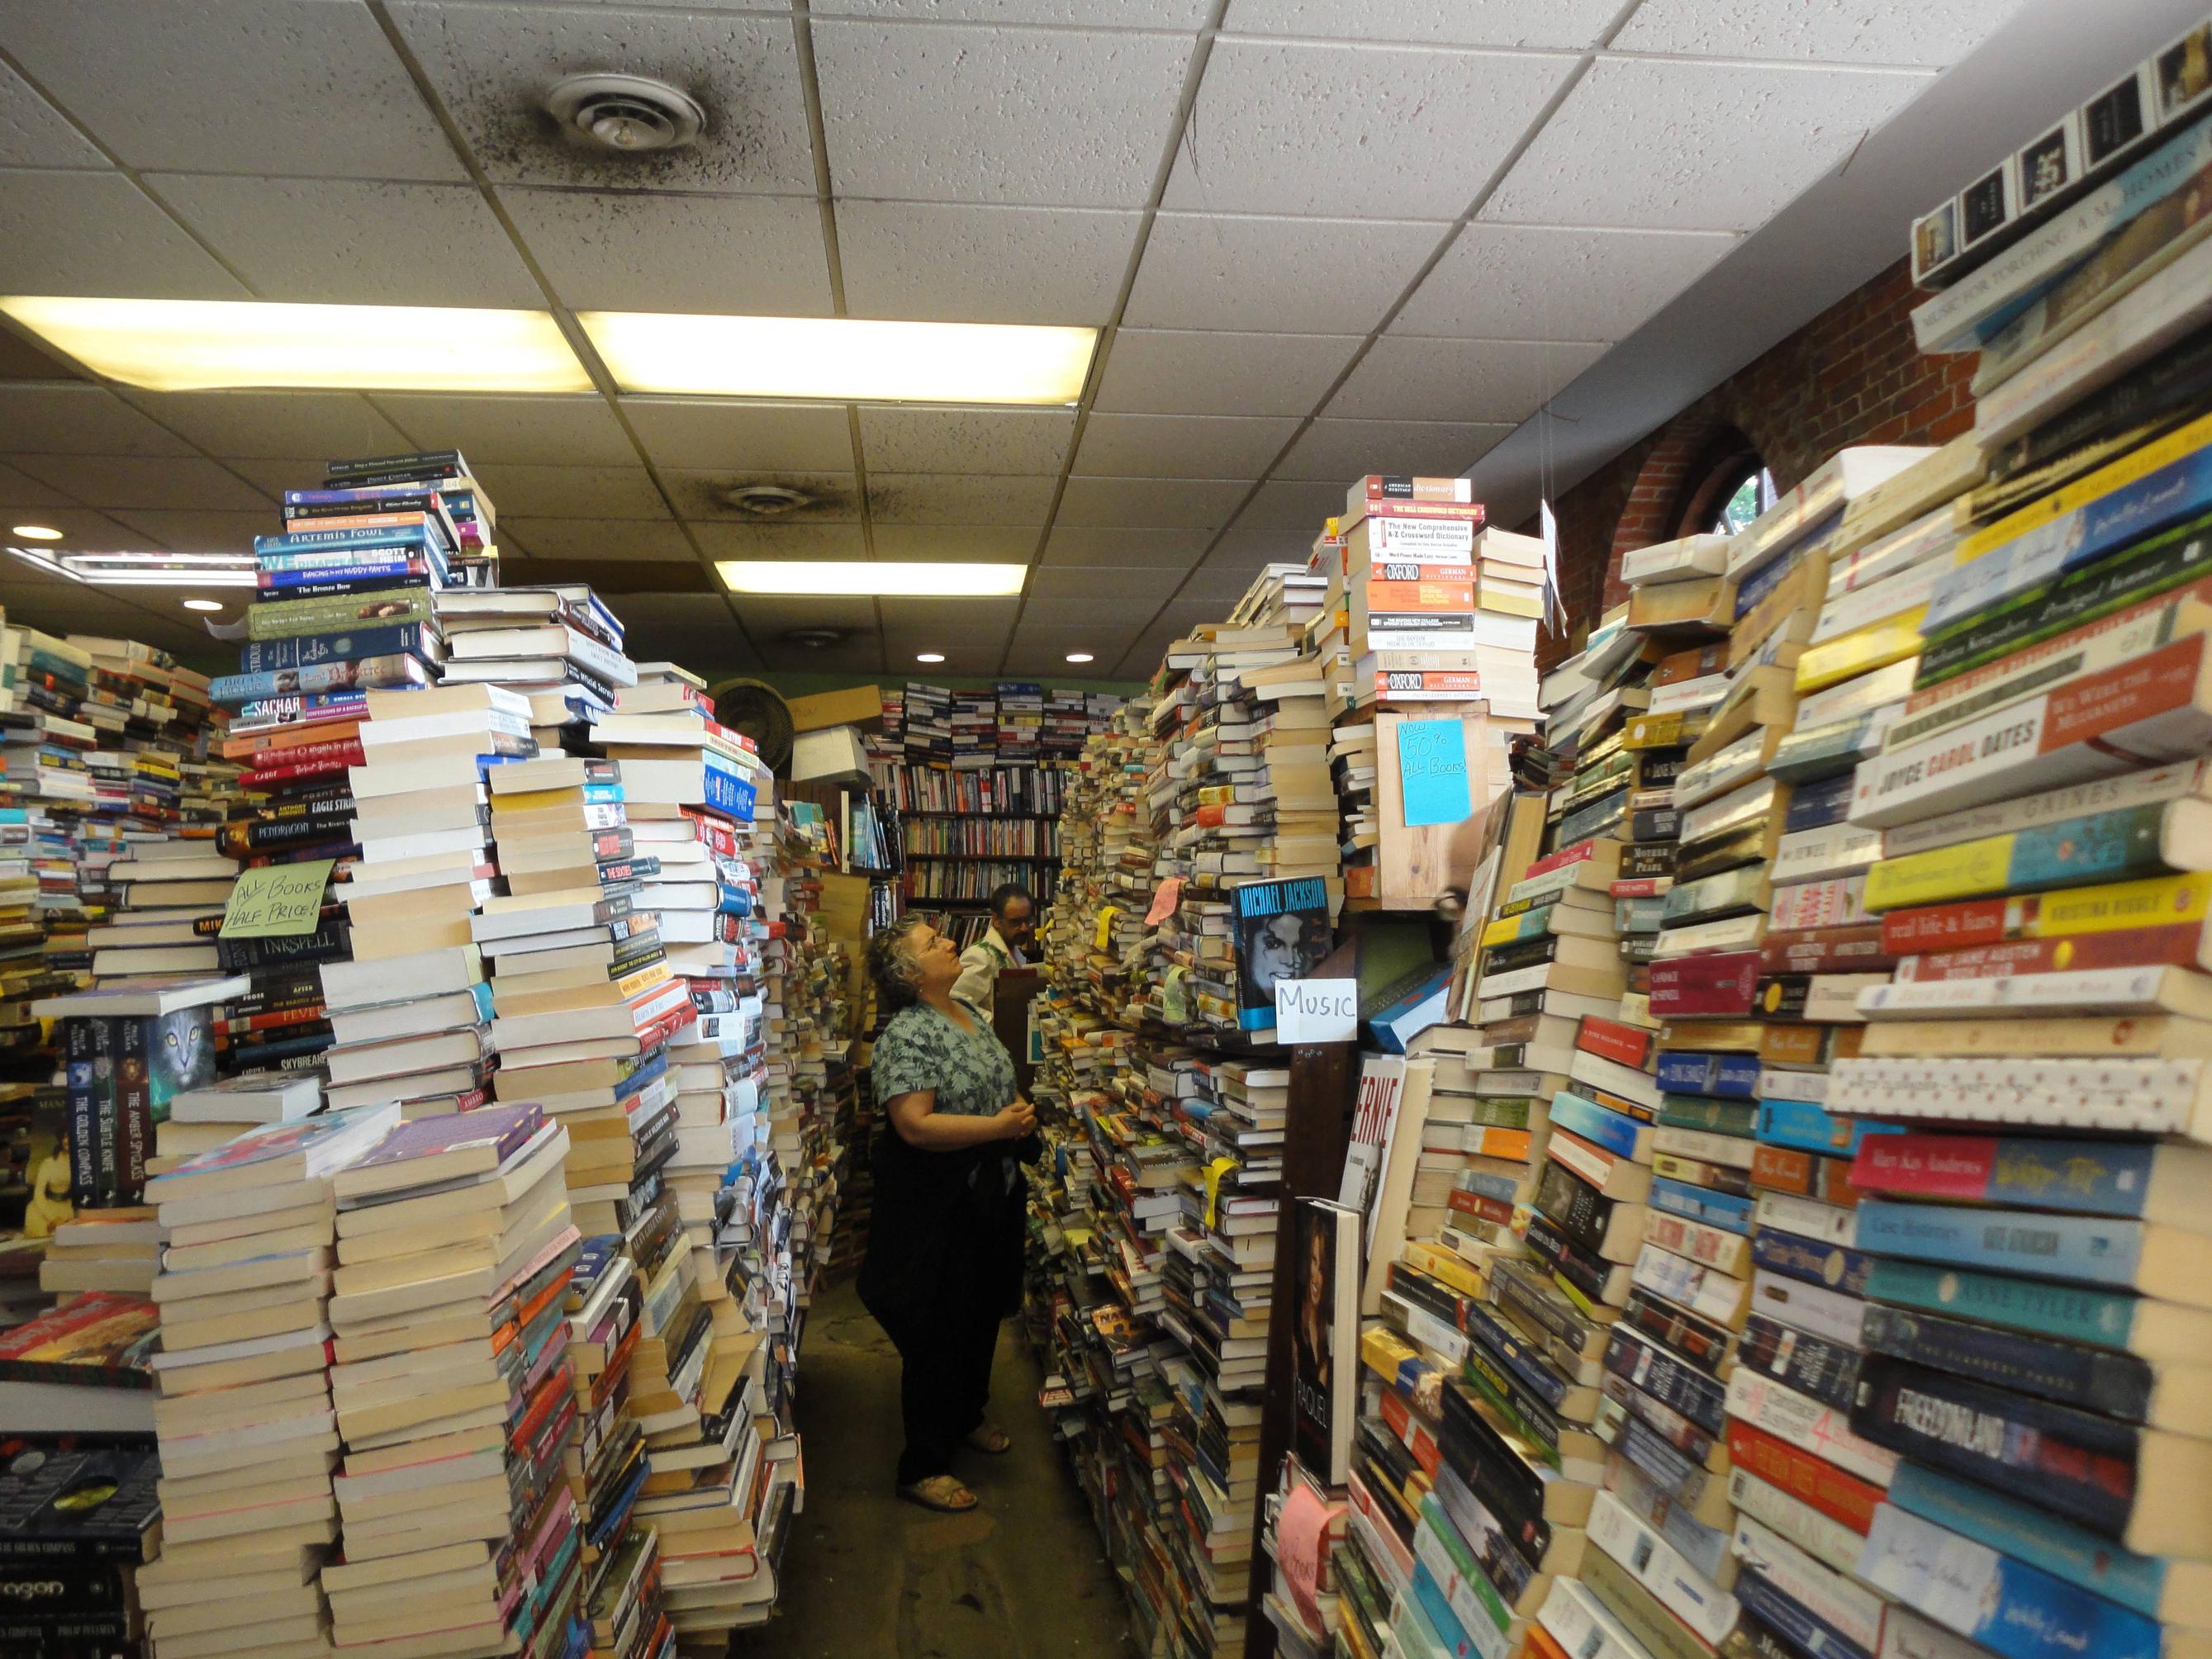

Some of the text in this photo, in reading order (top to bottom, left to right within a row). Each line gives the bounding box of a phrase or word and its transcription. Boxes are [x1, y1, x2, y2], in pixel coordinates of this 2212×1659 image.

[1413, 483, 1454, 495] dictionary
[290, 528, 384, 543] ARTEMIS FOWL
[1401, 531, 1434, 539] Crossword
[1436, 533, 1469, 541] Dictionary
[1418, 523, 1468, 533] Comprehensive
[302, 569, 329, 578] DANCING
[1387, 564, 1418, 580] OXFORD
[1440, 567, 1467, 576] GERMAN
[297, 586, 311, 595] The
[312, 584, 336, 593] Bronze
[1389, 673, 1422, 690] OXFORD
[254, 696, 301, 717] SACHAR
[1405, 732, 1447, 760] 50%
[1926, 741, 1976, 777] CAROL
[1982, 719, 2036, 757] OATES
[1403, 756, 1467, 777] ALL BOOKS!
[311, 799, 334, 814] EAGLE
[259, 822, 310, 839] PENDRAGON
[236, 875, 321, 906] ALL BOOKS
[1240, 879, 1327, 918] MICHAEL JACKSON
[225, 898, 318, 927] HALF PRICE!
[199, 919, 222, 931] MIK
[263, 931, 335, 955] INKSPELL
[76, 1097, 88, 1113] THE
[100, 1099, 112, 1116] THE
[128, 1092, 140, 1108] THE
[1350, 1076, 1398, 1149] ERNIE
